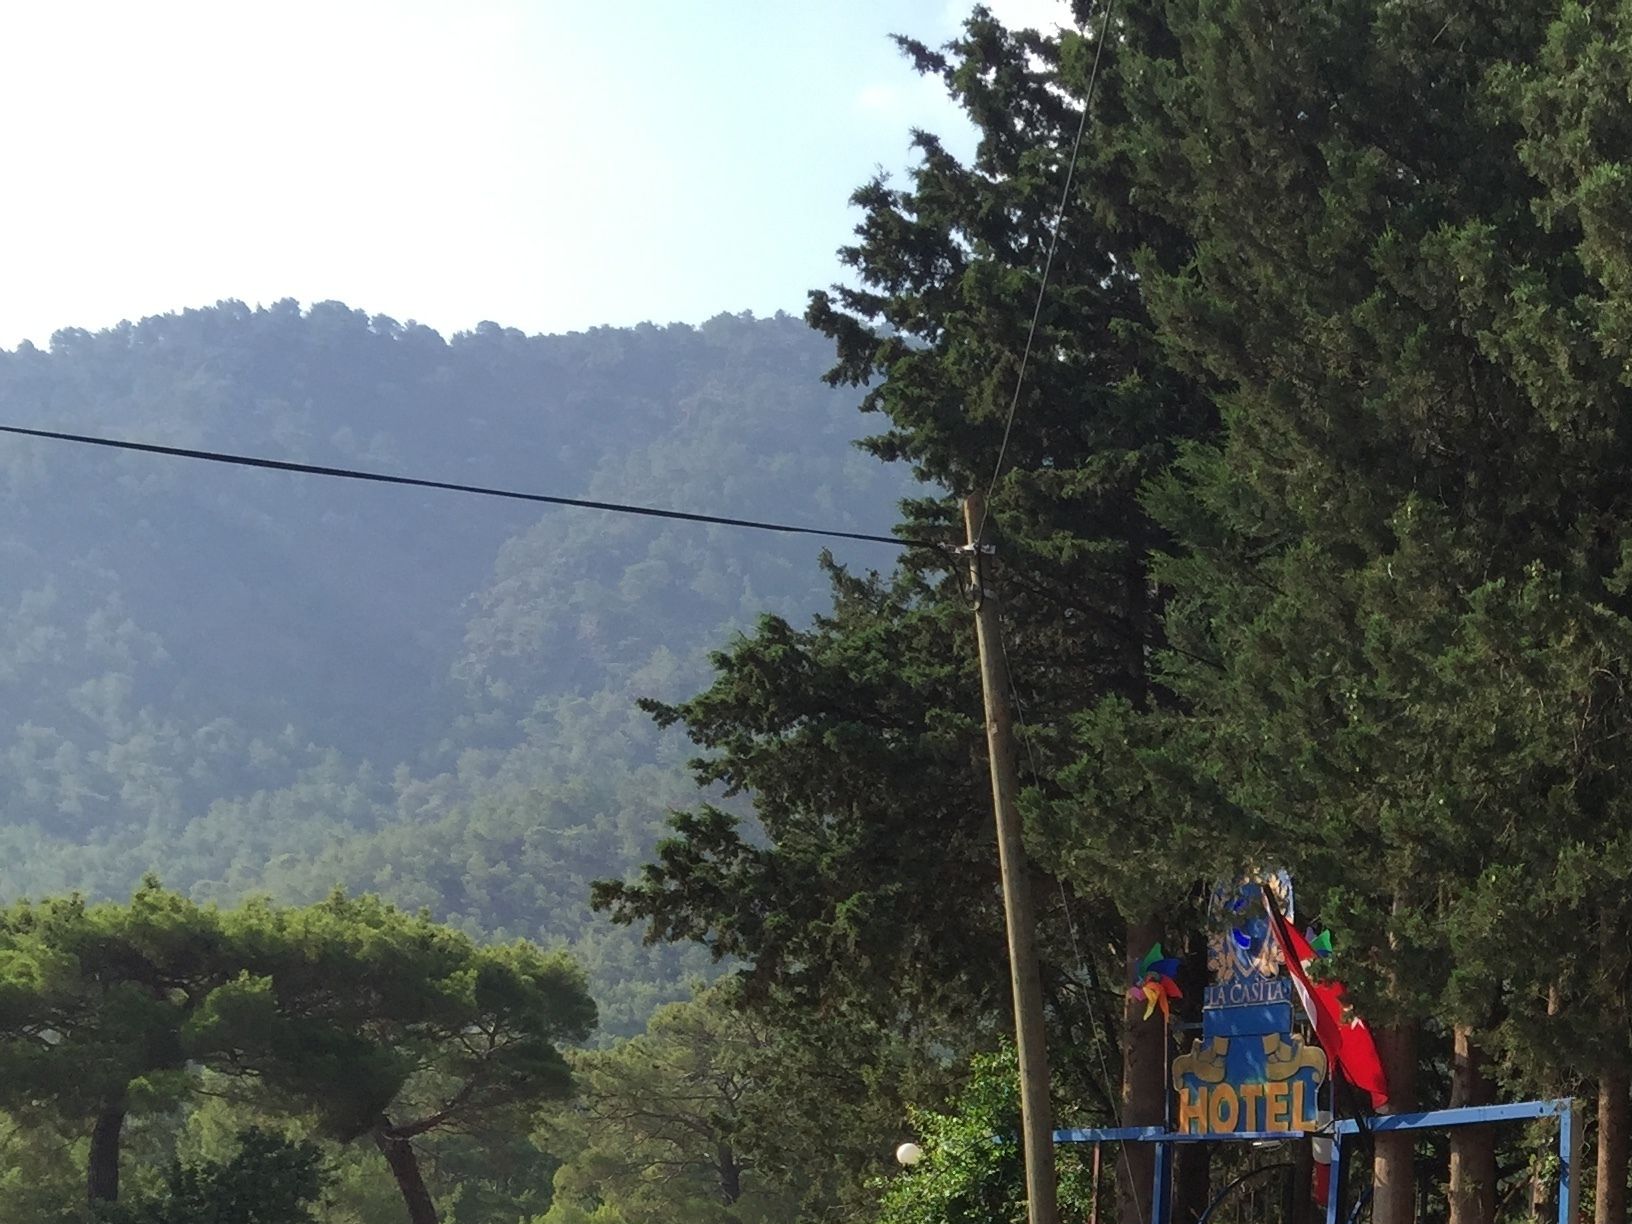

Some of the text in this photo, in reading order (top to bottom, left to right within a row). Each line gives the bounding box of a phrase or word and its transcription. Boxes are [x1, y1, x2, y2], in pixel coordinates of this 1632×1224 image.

[1209, 980, 1285, 1005] LA CASITA
[1179, 1080, 1317, 1135] HOTEL
